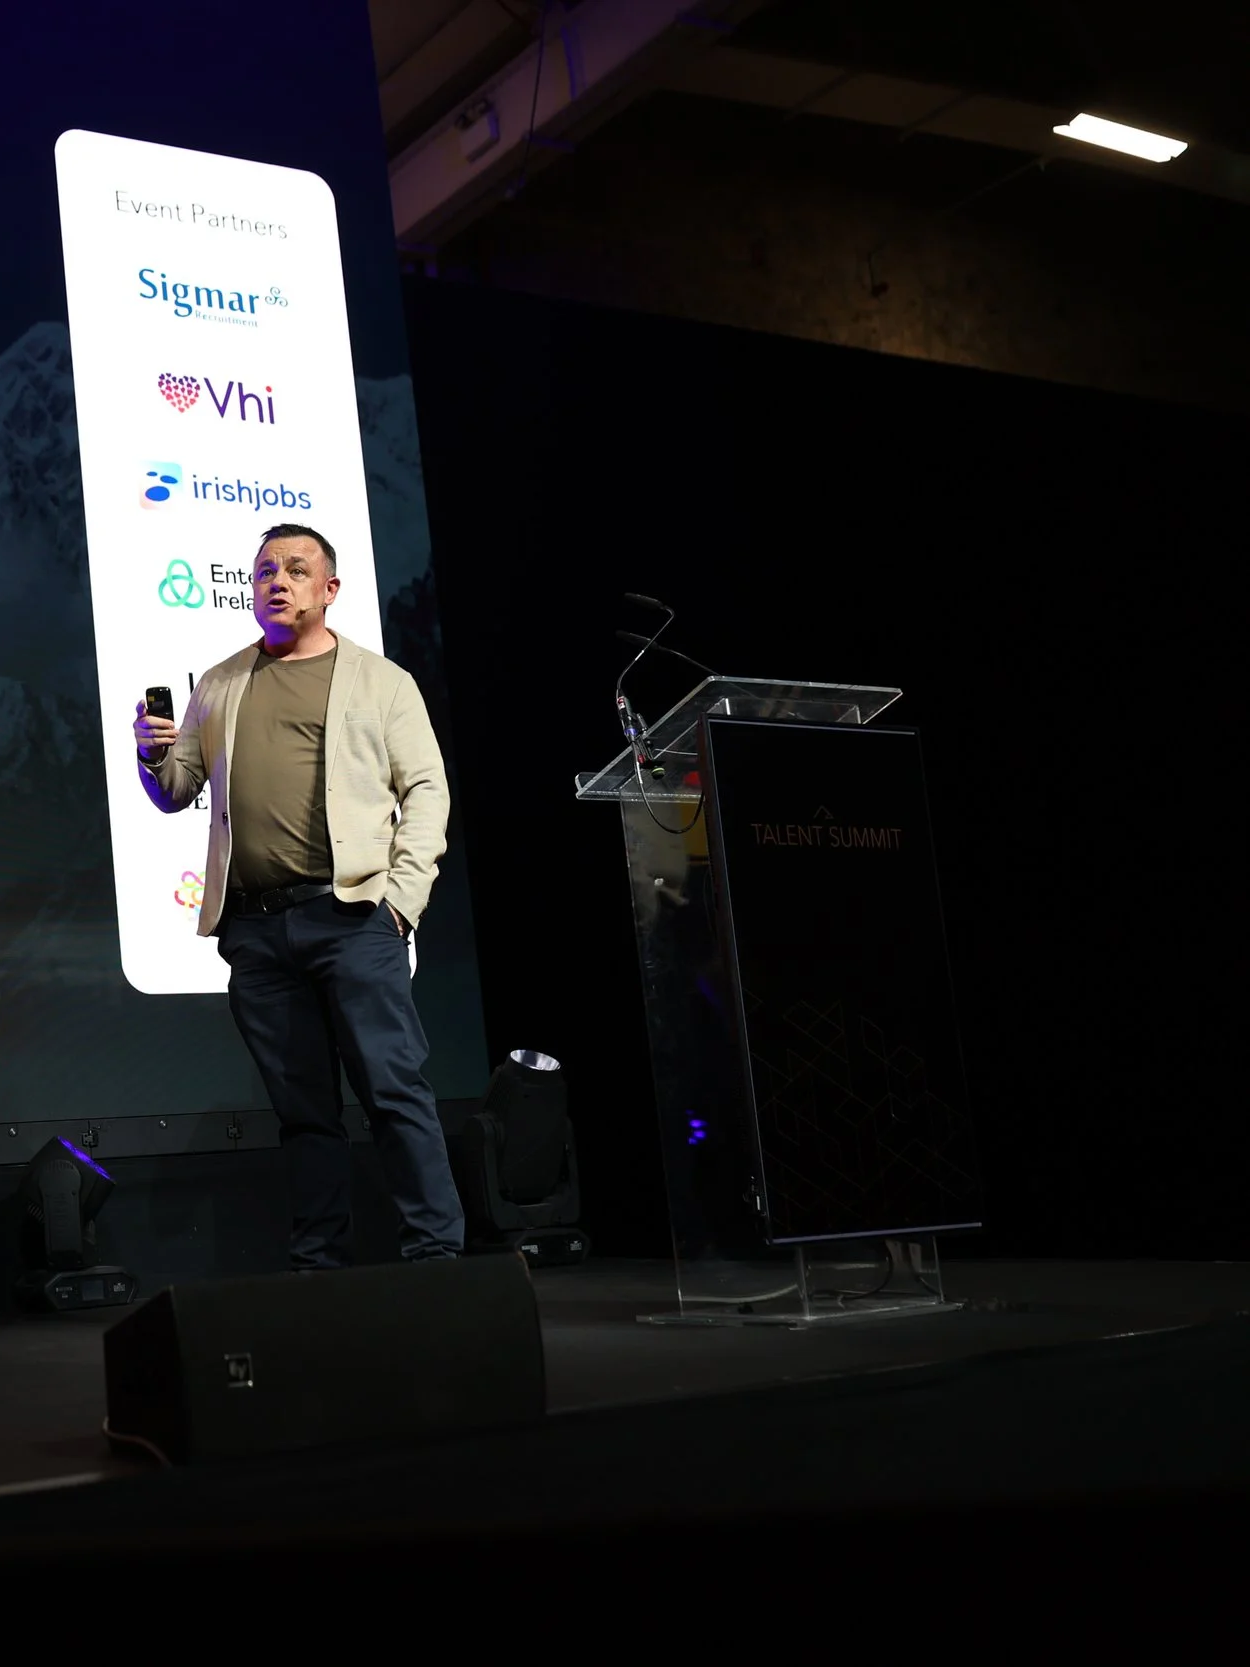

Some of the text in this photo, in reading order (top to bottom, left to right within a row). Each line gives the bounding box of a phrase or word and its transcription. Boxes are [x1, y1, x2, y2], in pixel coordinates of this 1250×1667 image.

[115, 190, 288, 239] Event Partners
[138, 268, 260, 318] Sigmar
[195, 309, 258, 328] Recruitment
[203, 377, 275, 425] Vhi
[192, 474, 313, 512] irishjobs
[750, 823, 902, 849] TALENT SUMMIT
